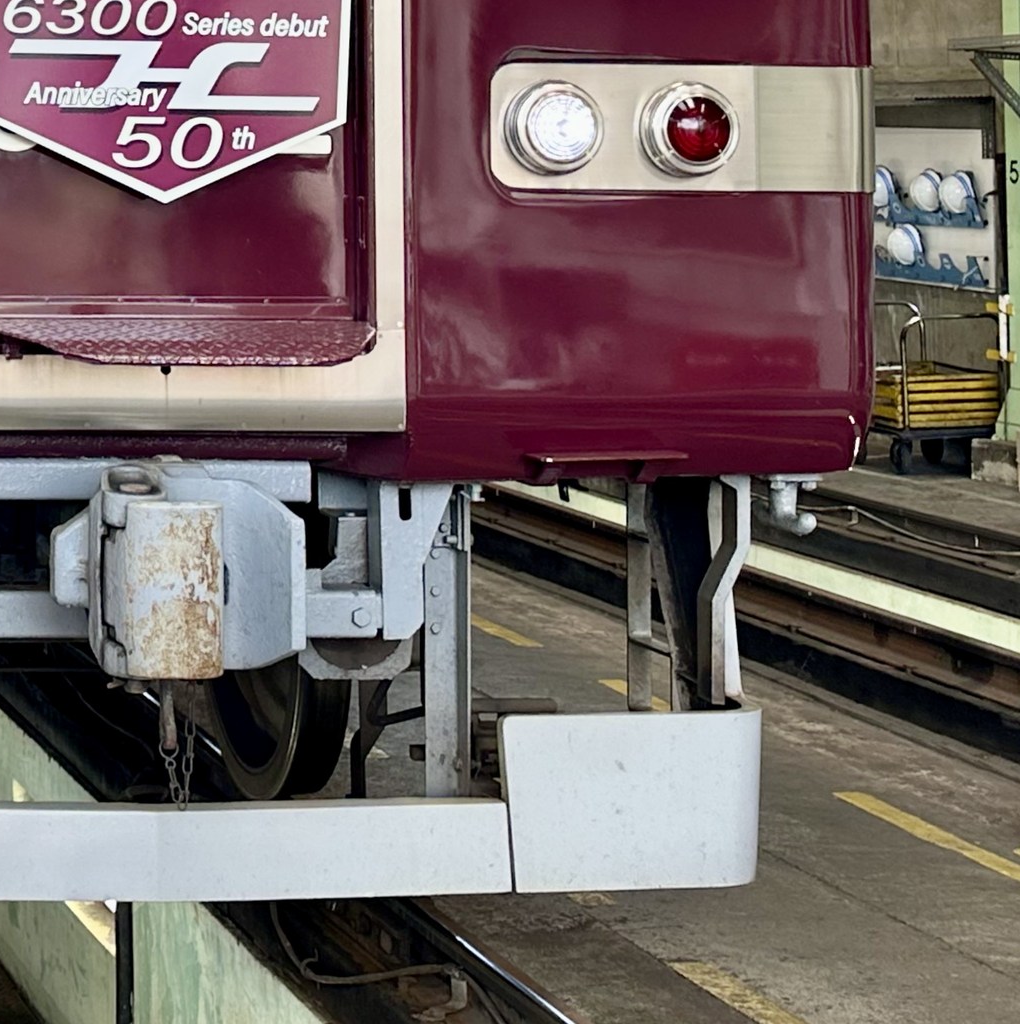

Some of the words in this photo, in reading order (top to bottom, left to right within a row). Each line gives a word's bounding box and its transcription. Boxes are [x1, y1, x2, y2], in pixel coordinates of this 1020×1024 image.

[182, 12, 254, 37] Series
[260, 13, 329, 38] debut
[23, 81, 167, 112] Anniversary
[111, 116, 223, 170] 50
[231, 126, 255, 151] th
[1010, 160, 1019, 184] 5
